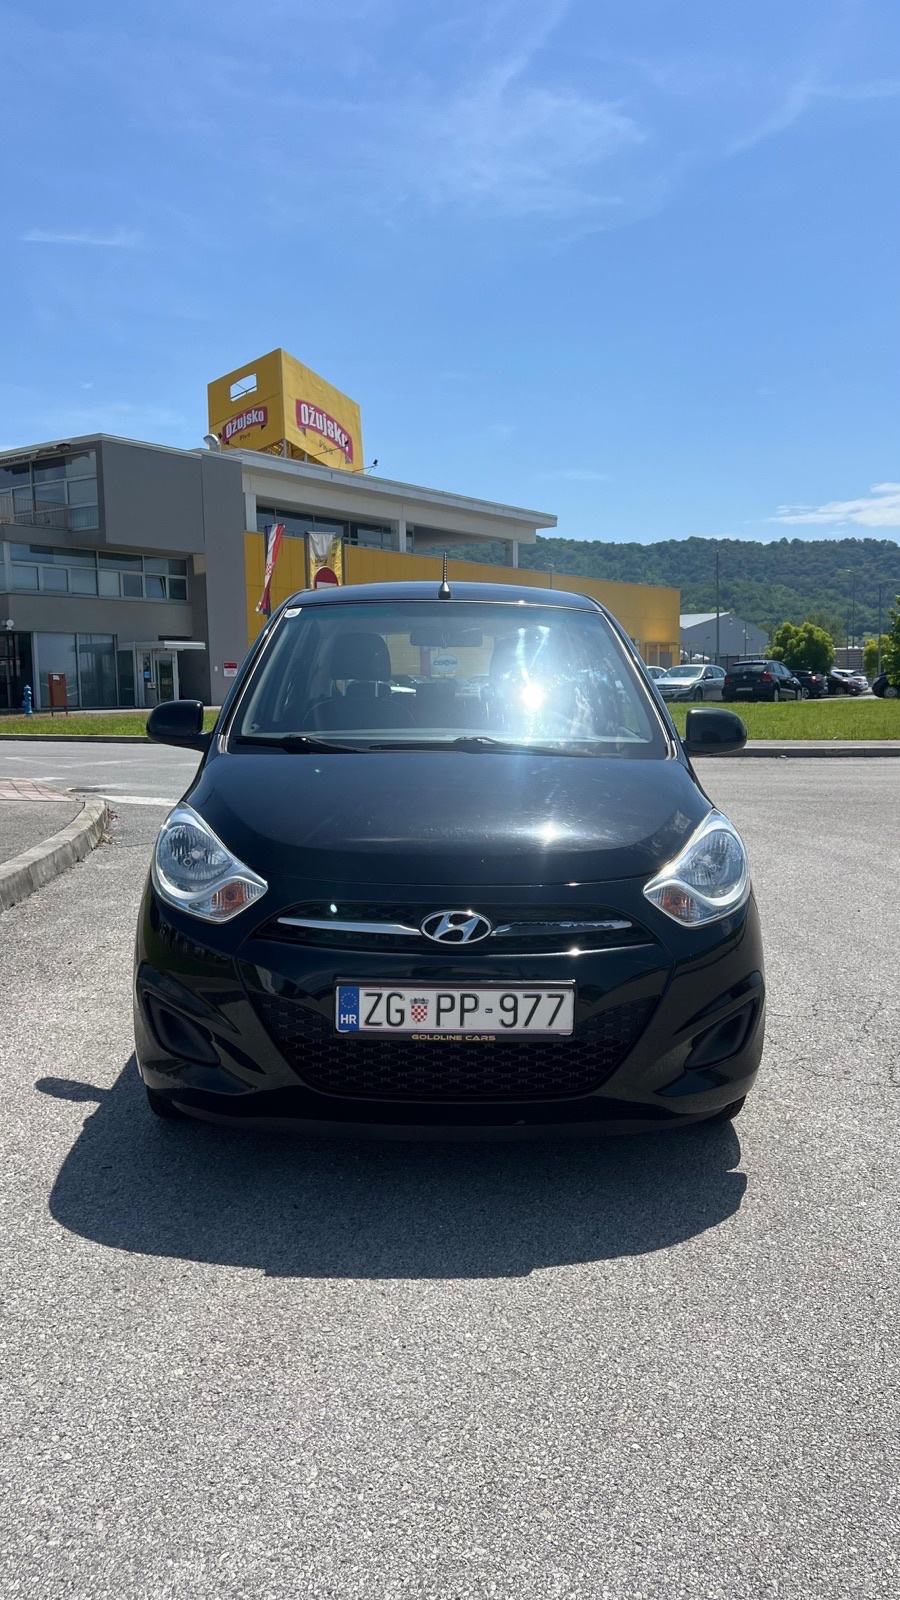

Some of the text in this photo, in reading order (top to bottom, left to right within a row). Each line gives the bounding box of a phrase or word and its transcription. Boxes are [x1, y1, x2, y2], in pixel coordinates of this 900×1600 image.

[225, 409, 265, 439] Ožujsko
[340, 1014, 357, 1025] HR
[364, 992, 405, 1027] ZG
